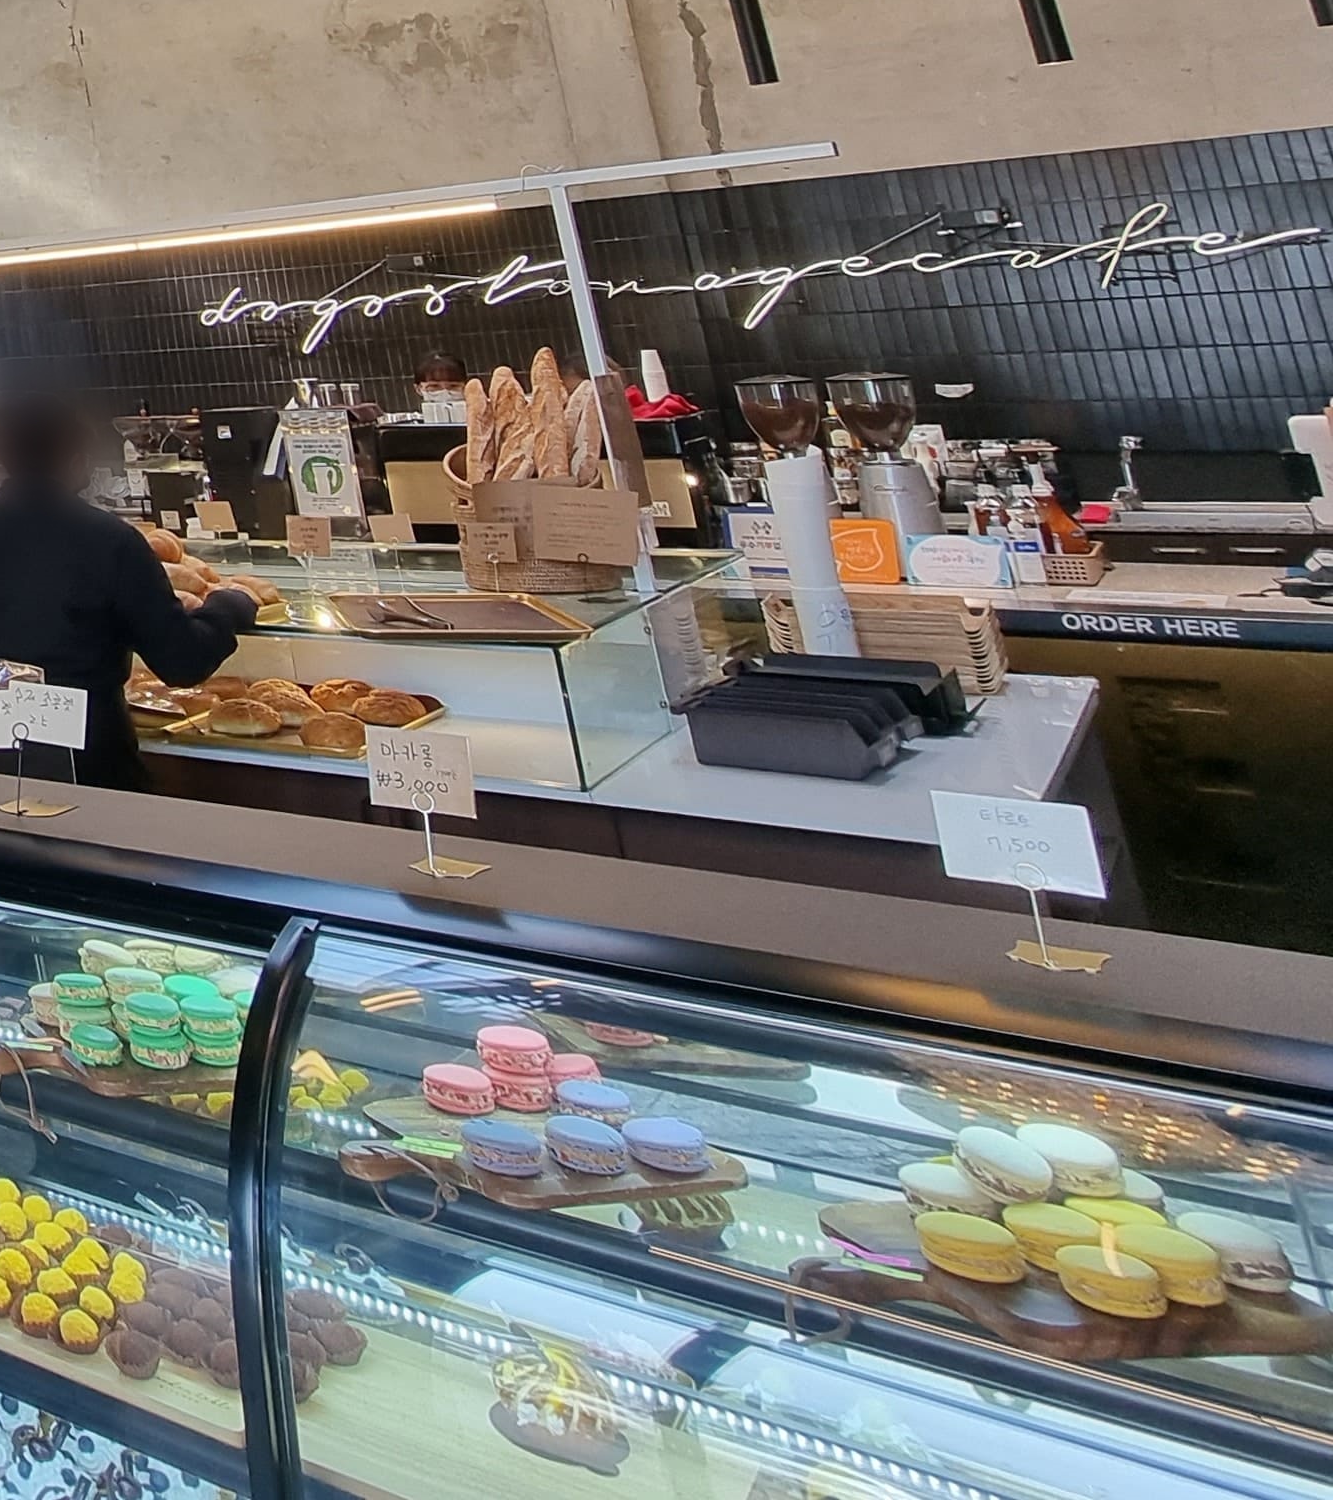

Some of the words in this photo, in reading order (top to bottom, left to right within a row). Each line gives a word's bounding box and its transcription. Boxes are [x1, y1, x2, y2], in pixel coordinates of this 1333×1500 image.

[1061, 613, 1156, 635] ORDER
[1162, 618, 1241, 639] HERE
[380, 739, 434, 768] 마카롱
[987, 835, 1051, 853] 7,500
